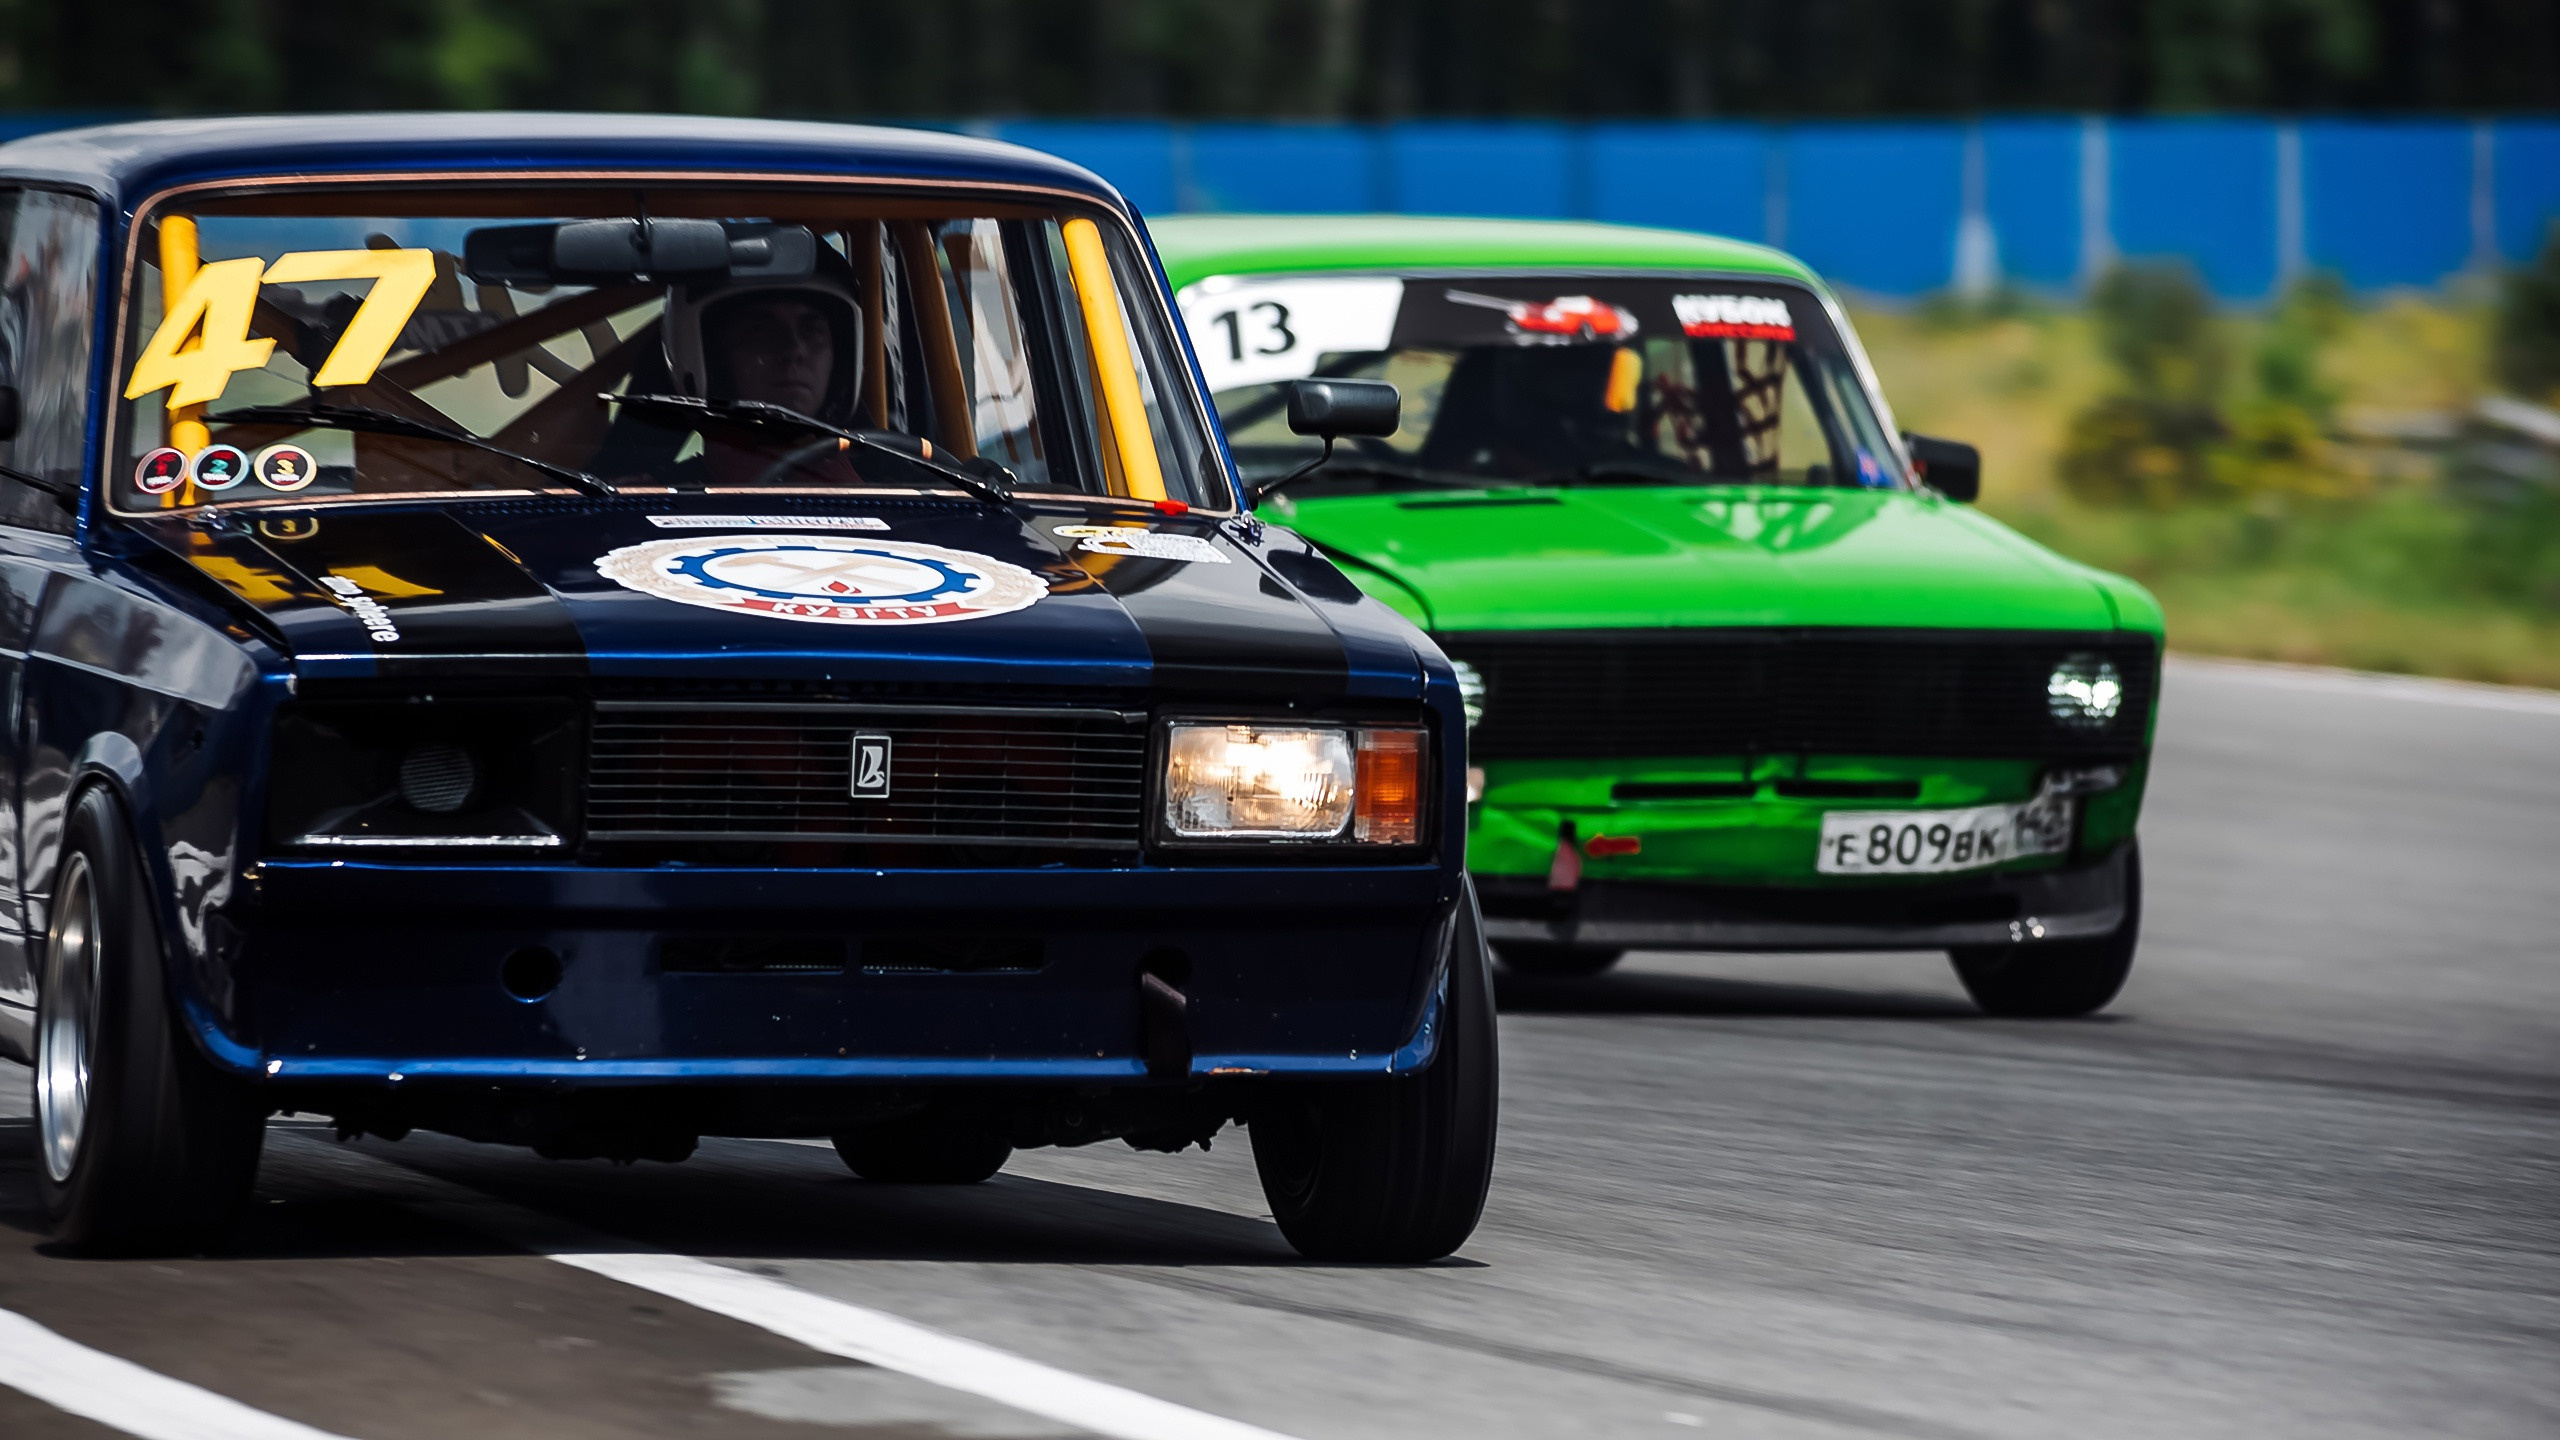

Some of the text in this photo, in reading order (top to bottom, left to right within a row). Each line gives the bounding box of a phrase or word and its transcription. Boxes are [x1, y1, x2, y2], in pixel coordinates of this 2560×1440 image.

[124, 248, 436, 410] 47
[1212, 302, 1295, 360] 13
[772, 602, 937, 620] КУЗГТУ
